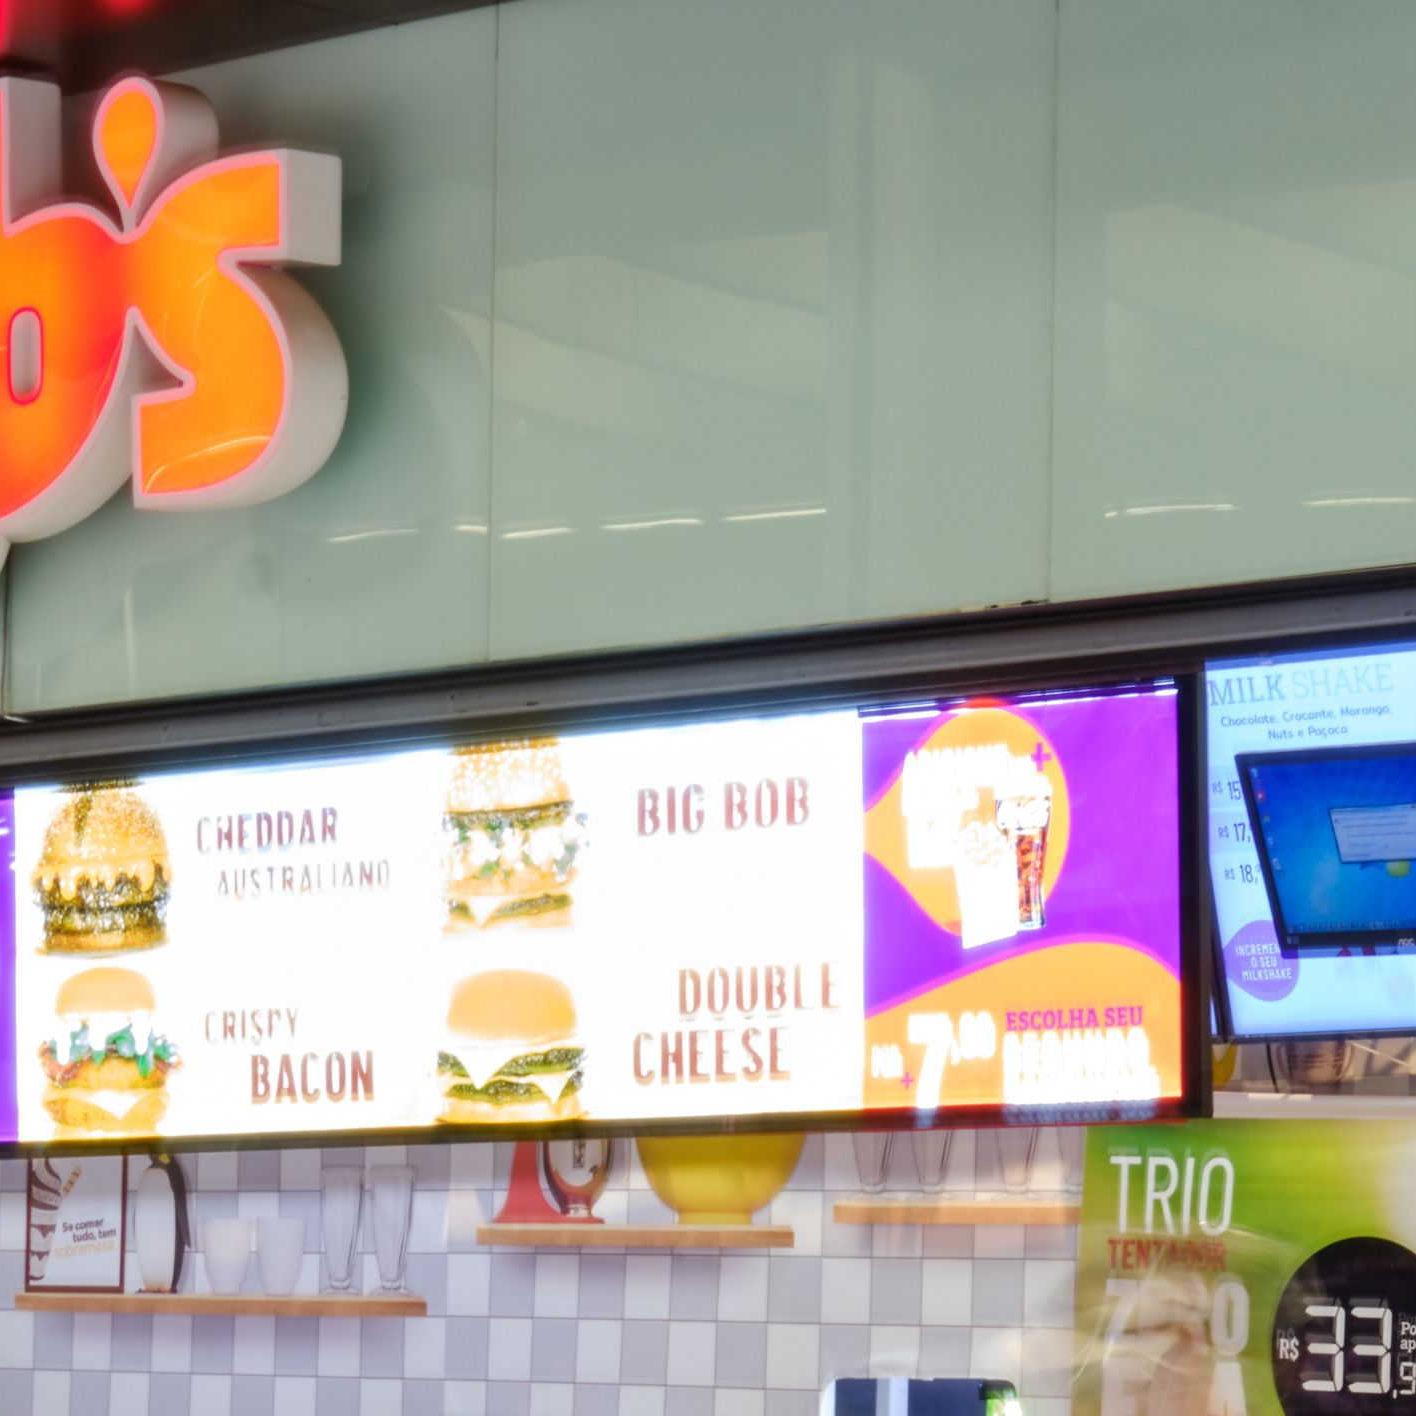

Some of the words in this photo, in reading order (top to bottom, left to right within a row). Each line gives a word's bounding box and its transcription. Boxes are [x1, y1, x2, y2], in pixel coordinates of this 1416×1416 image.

[1207, 673, 1287, 707] MILK
[1291, 662, 1395, 700] SHAKE
[1220, 714, 1280, 728] Chocolate,
[1268, 727, 1294, 740] Nuts
[1297, 729, 1304, 738] e
[1307, 725, 1348, 740] Paçoca
[636, 783, 705, 837] BIG
[724, 777, 811, 831] BOB
[196, 807, 338, 854] CHEDDAR
[217, 858, 391, 900] AUSTRALIANO
[678, 961, 839, 1016] DOUBLE
[204, 1006, 299, 1046] CRISPY
[1005, 1007, 1099, 1033] ESCOLHA
[1104, 1005, 1144, 1028] SEU
[251, 1050, 375, 1104] BACON
[632, 1027, 792, 1087] CHEESE
[1109, 1154, 1235, 1237] TRIO
[62, 1222, 73, 1233] Se
[74, 1218, 105, 1231] comer
[72, 1230, 97, 1243] tudo,
[98, 1229, 117, 1240] tem
[1278, 1336, 1300, 1362] R$
